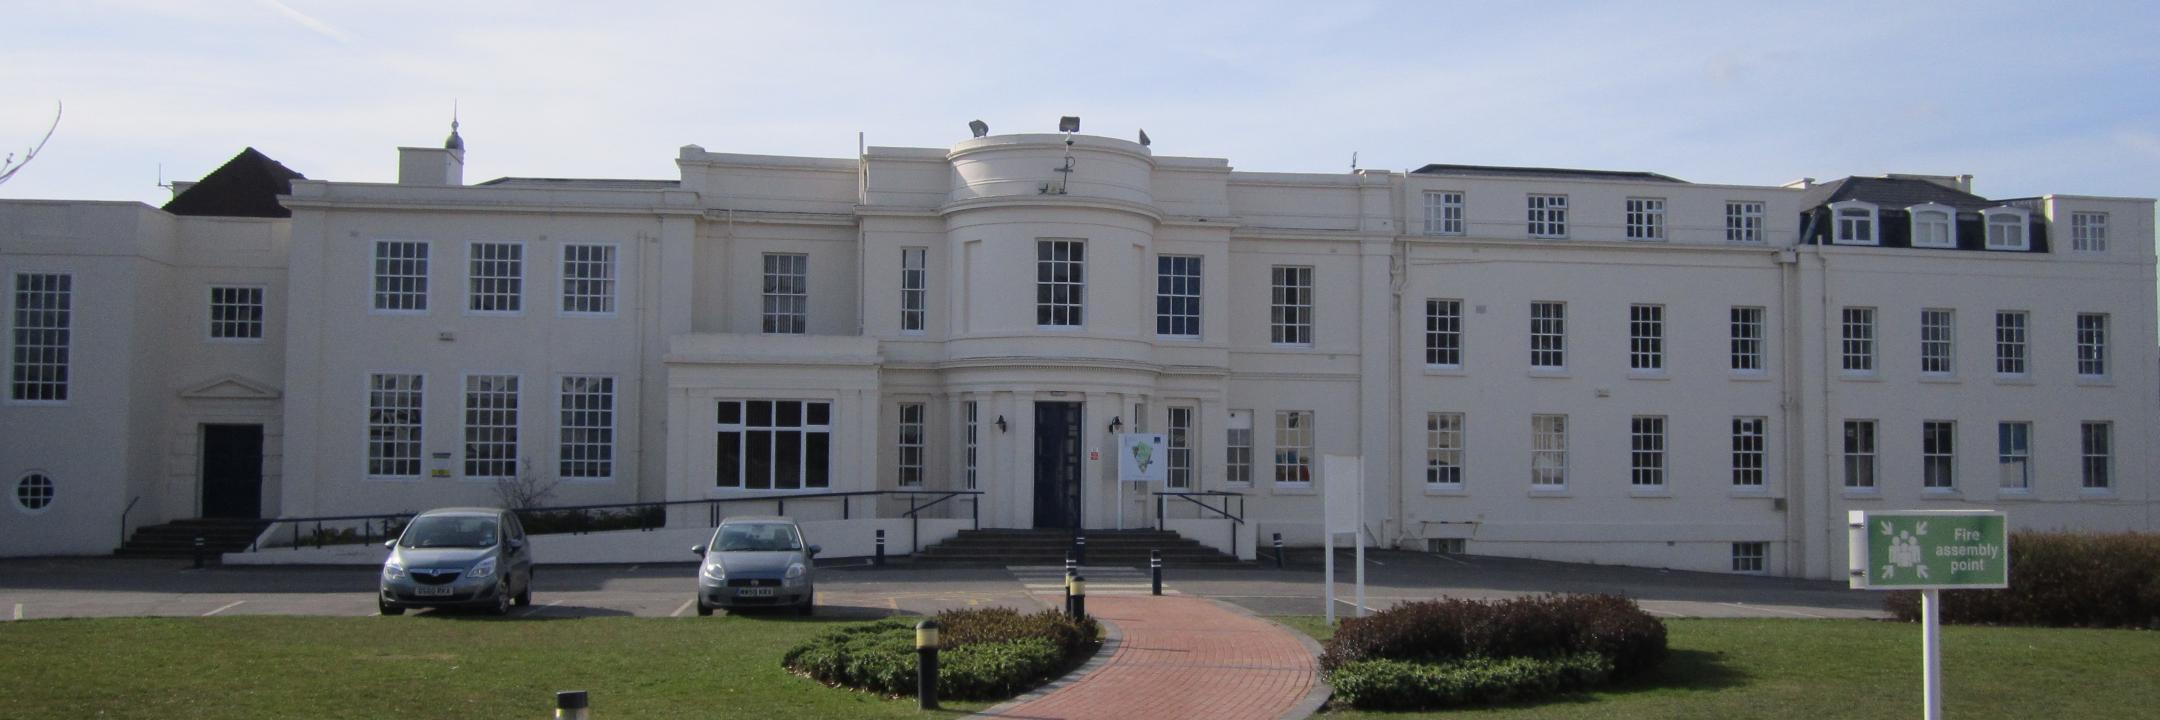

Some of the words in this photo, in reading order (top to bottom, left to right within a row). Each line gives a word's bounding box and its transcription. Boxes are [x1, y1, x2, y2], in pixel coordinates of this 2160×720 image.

[1954, 528, 1980, 541] Fire
[1935, 544, 1998, 559] assembly
[1951, 559, 1984, 574] point
